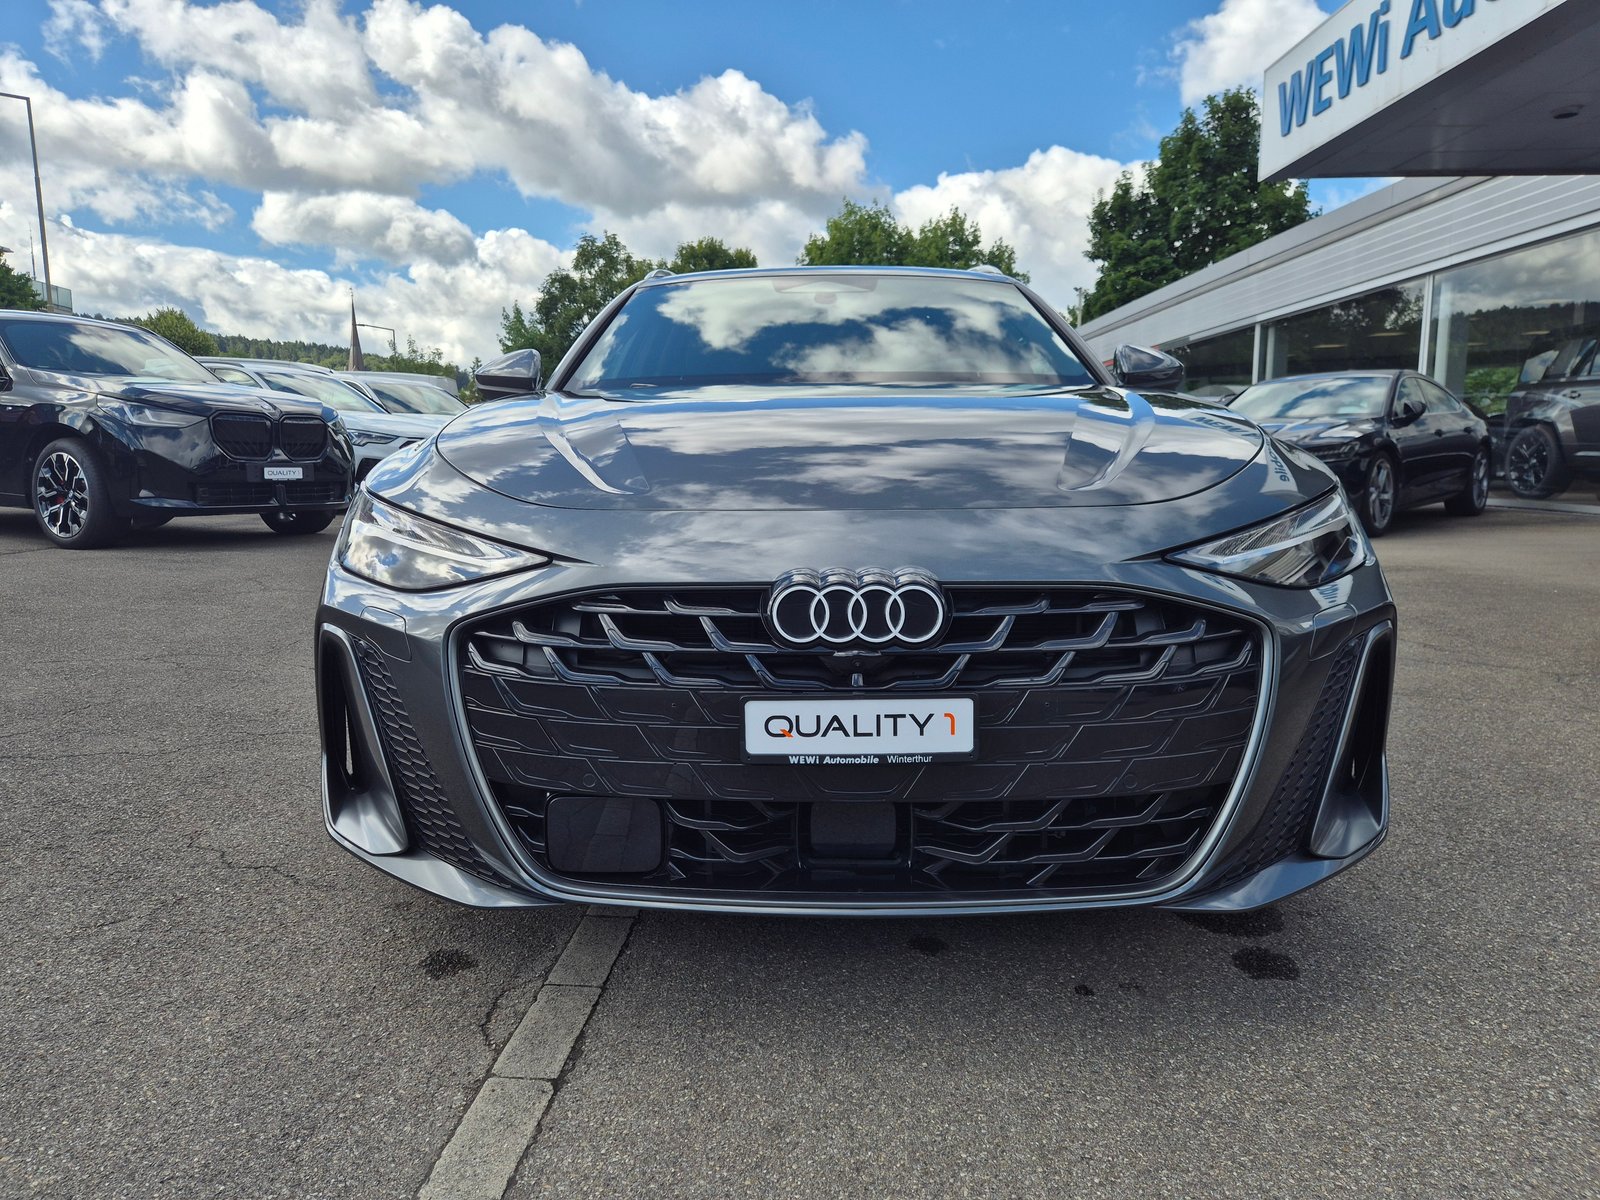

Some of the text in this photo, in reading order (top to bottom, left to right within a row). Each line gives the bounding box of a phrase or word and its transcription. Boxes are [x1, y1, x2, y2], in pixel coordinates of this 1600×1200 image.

[1277, 0, 1390, 137] WEWi
[764, 712, 956, 738] QUALITY 1
[788, 754, 933, 764] WEWi Automobile Winterthur
